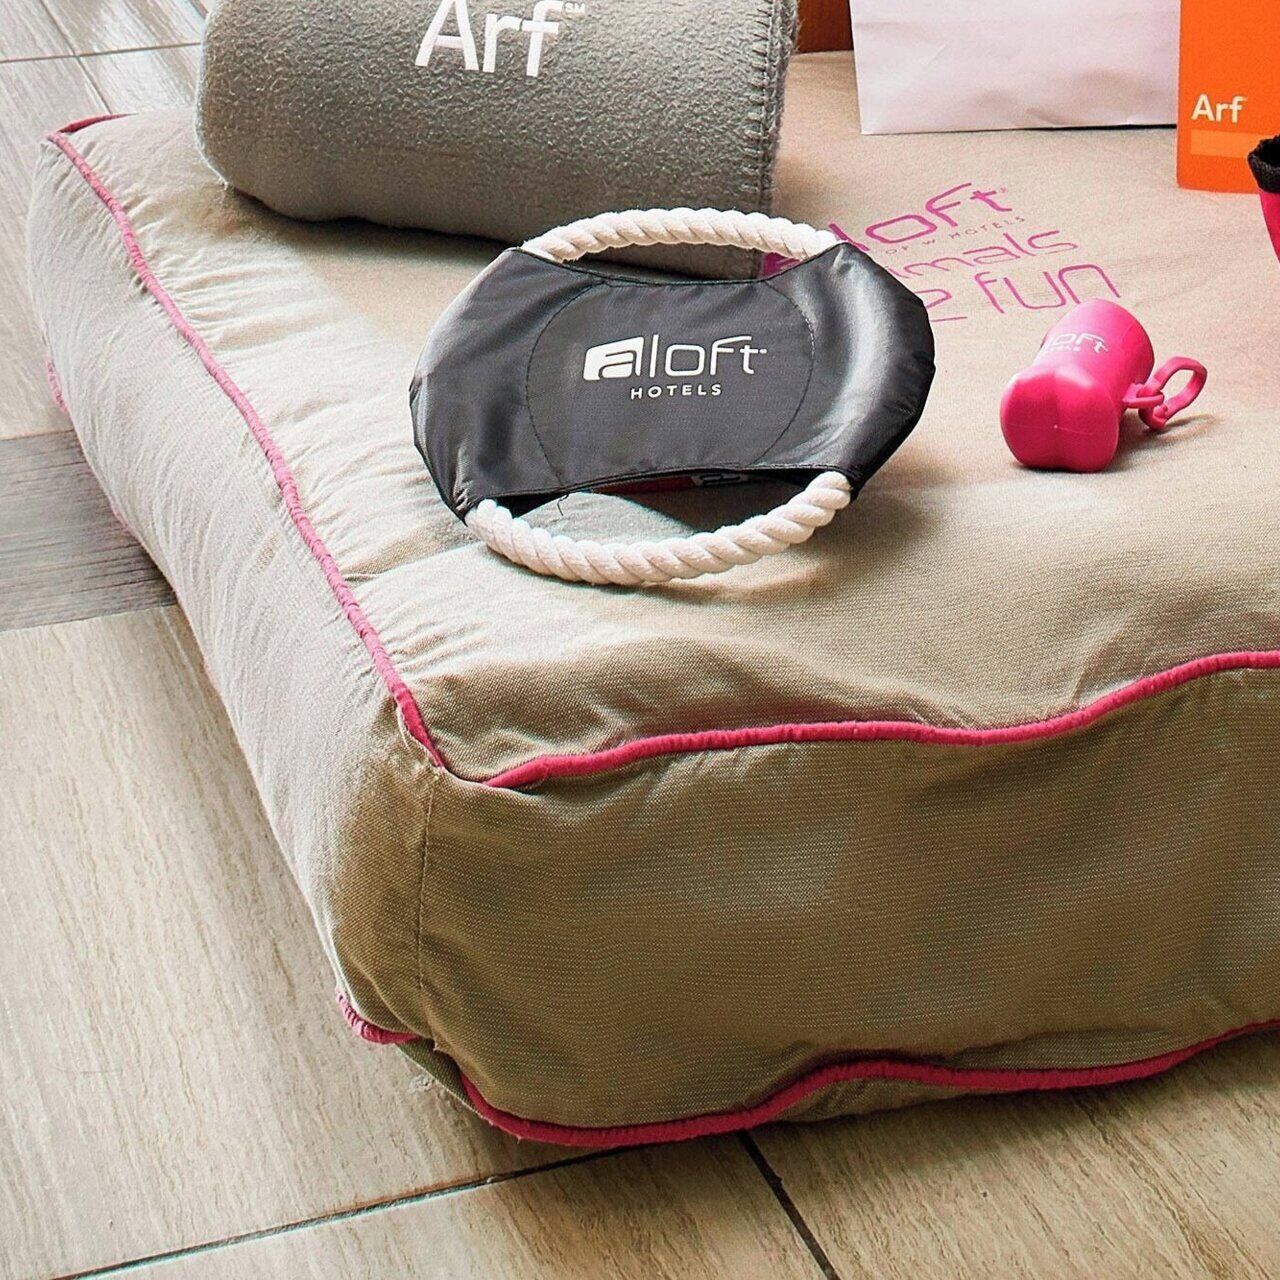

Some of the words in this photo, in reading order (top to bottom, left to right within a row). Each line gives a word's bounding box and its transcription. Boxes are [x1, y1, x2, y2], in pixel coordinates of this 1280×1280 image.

[1190, 92, 1246, 124] Arf
[827, 182, 1013, 253] loft
[885, 230, 1079, 279] imals
[974, 264, 1121, 314] fun
[583, 333, 768, 381] aloft
[630, 383, 723, 401] HOTELS
